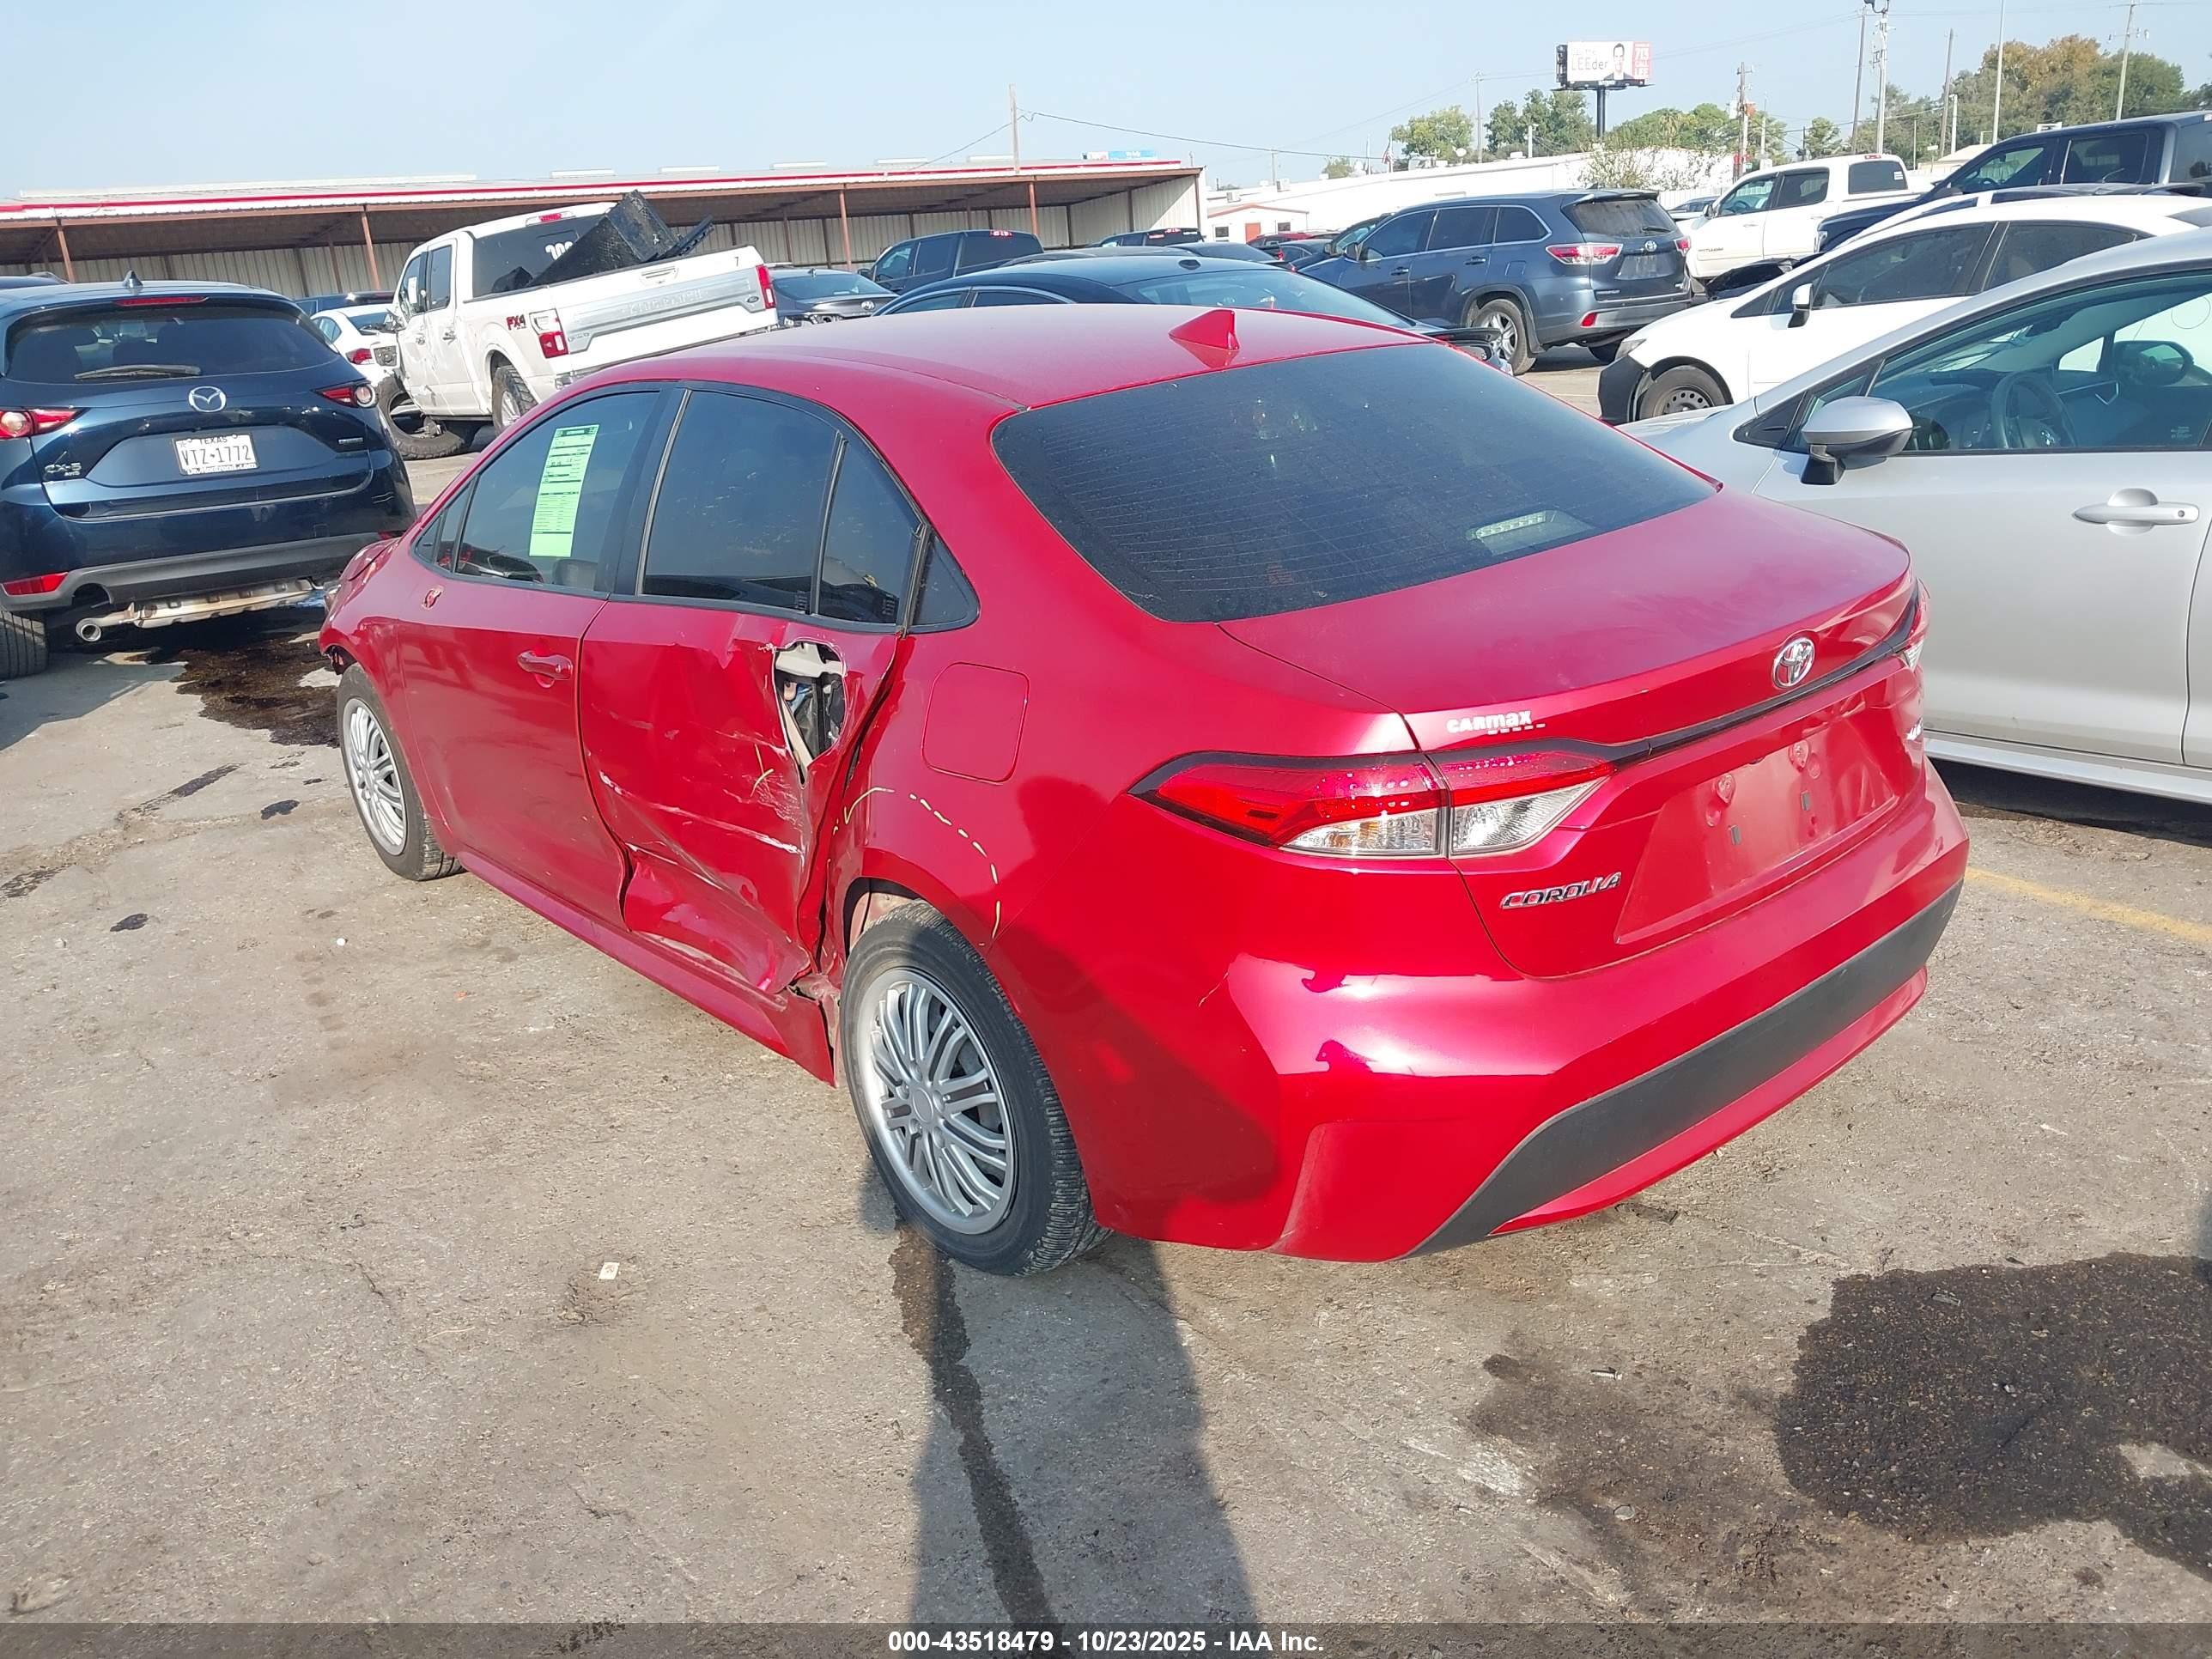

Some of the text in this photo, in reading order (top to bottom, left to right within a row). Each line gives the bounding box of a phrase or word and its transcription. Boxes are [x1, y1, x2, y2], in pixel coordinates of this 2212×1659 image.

[507, 314, 526, 330] FX4
[45, 462, 82, 473] CX-5
[1500, 872, 1622, 909] COROLLA
